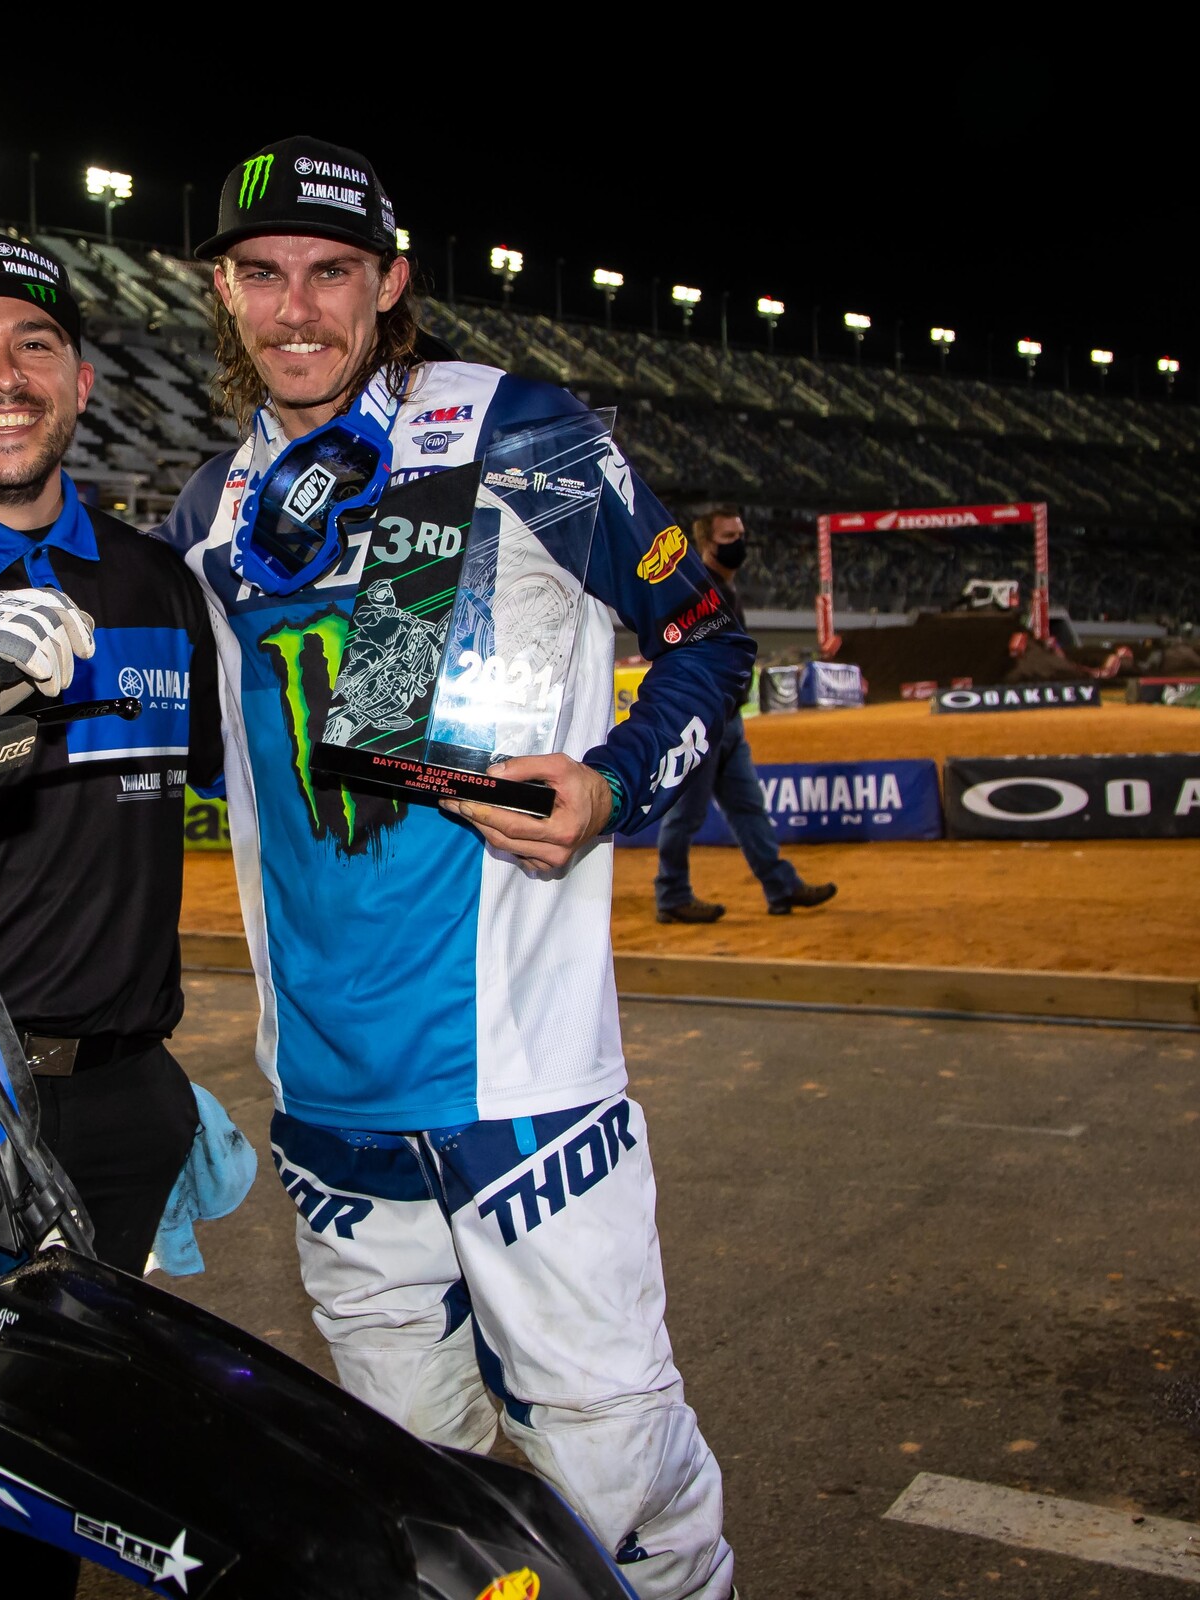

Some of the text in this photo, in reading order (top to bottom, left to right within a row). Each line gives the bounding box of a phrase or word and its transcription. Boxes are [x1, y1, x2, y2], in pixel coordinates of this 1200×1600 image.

[313, 160, 369, 186] YAMAHA
[299, 181, 363, 207] YAMALUBE
[12, 246, 60, 279] YAMAHA
[411, 405, 484, 422] AMA
[426, 438, 446, 447] FIM
[292, 470, 327, 514] 100%
[898, 513, 979, 529] HONDA
[372, 516, 463, 564] 3RD
[643, 526, 686, 581] FMF
[458, 650, 554, 710] 2021
[983, 686, 1094, 707] OAKLEY
[372, 756, 497, 788] DAYTONA SUPERCROSS
[416, 774, 449, 787] 450SX
[405, 779, 431, 790] MARCH
[440, 786, 457, 795] 2021
[762, 773, 903, 814] YAMAHA
[477, 1098, 638, 1248] THOR
